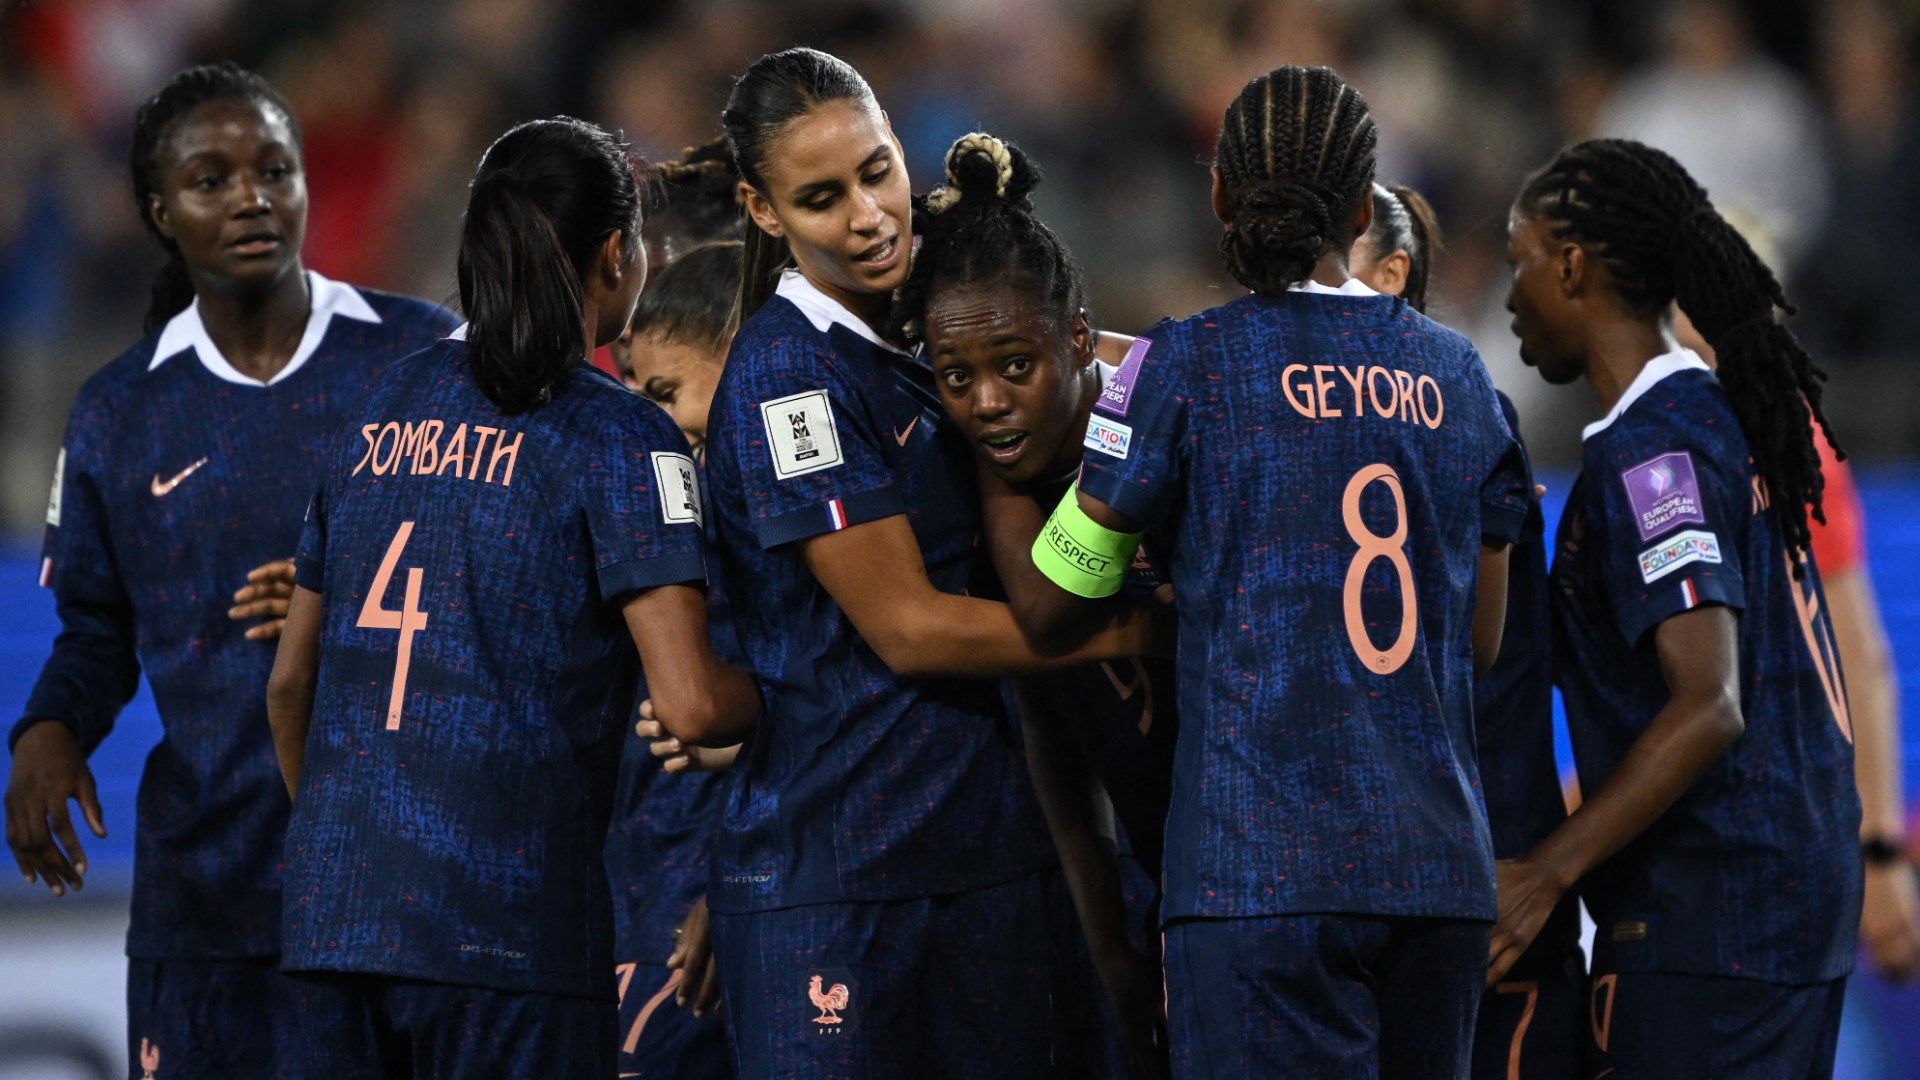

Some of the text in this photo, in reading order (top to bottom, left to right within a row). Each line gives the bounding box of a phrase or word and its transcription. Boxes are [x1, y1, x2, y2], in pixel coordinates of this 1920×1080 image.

[1281, 363, 1444, 430] GEYORO
[352, 419, 525, 487] SOMBATH
[1643, 497, 1695, 522] EUROPEAN
[1645, 505, 1698, 530] QUALIFIERS
[1049, 525, 1110, 573] RESPECT
[1342, 463, 1418, 676] 8
[356, 521, 428, 731] 4
